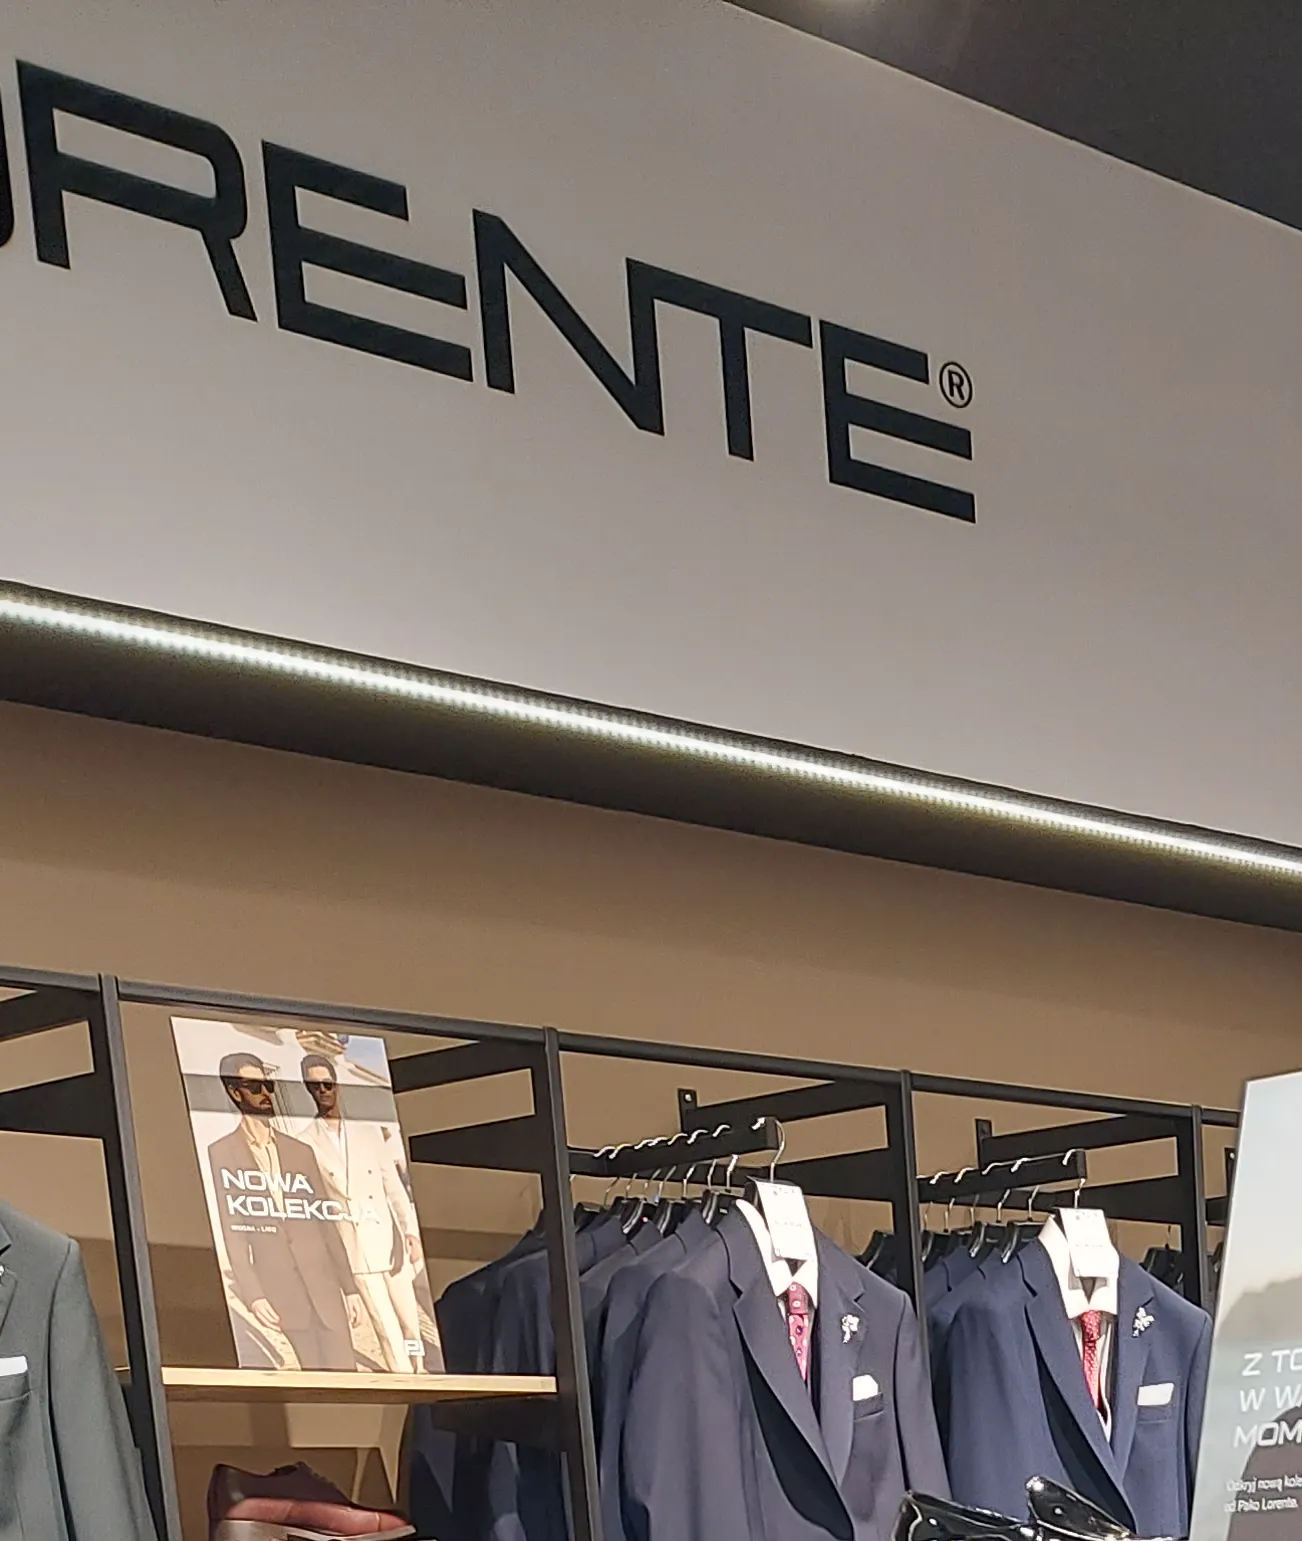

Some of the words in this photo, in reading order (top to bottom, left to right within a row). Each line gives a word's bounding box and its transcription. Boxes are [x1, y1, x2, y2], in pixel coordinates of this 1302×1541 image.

[220, 1168, 314, 1194] NOWA
[225, 1195, 383, 1222] KOLEKCJA
[1241, 1352, 1263, 1376] Z
[1239, 1388, 1265, 1412] W
